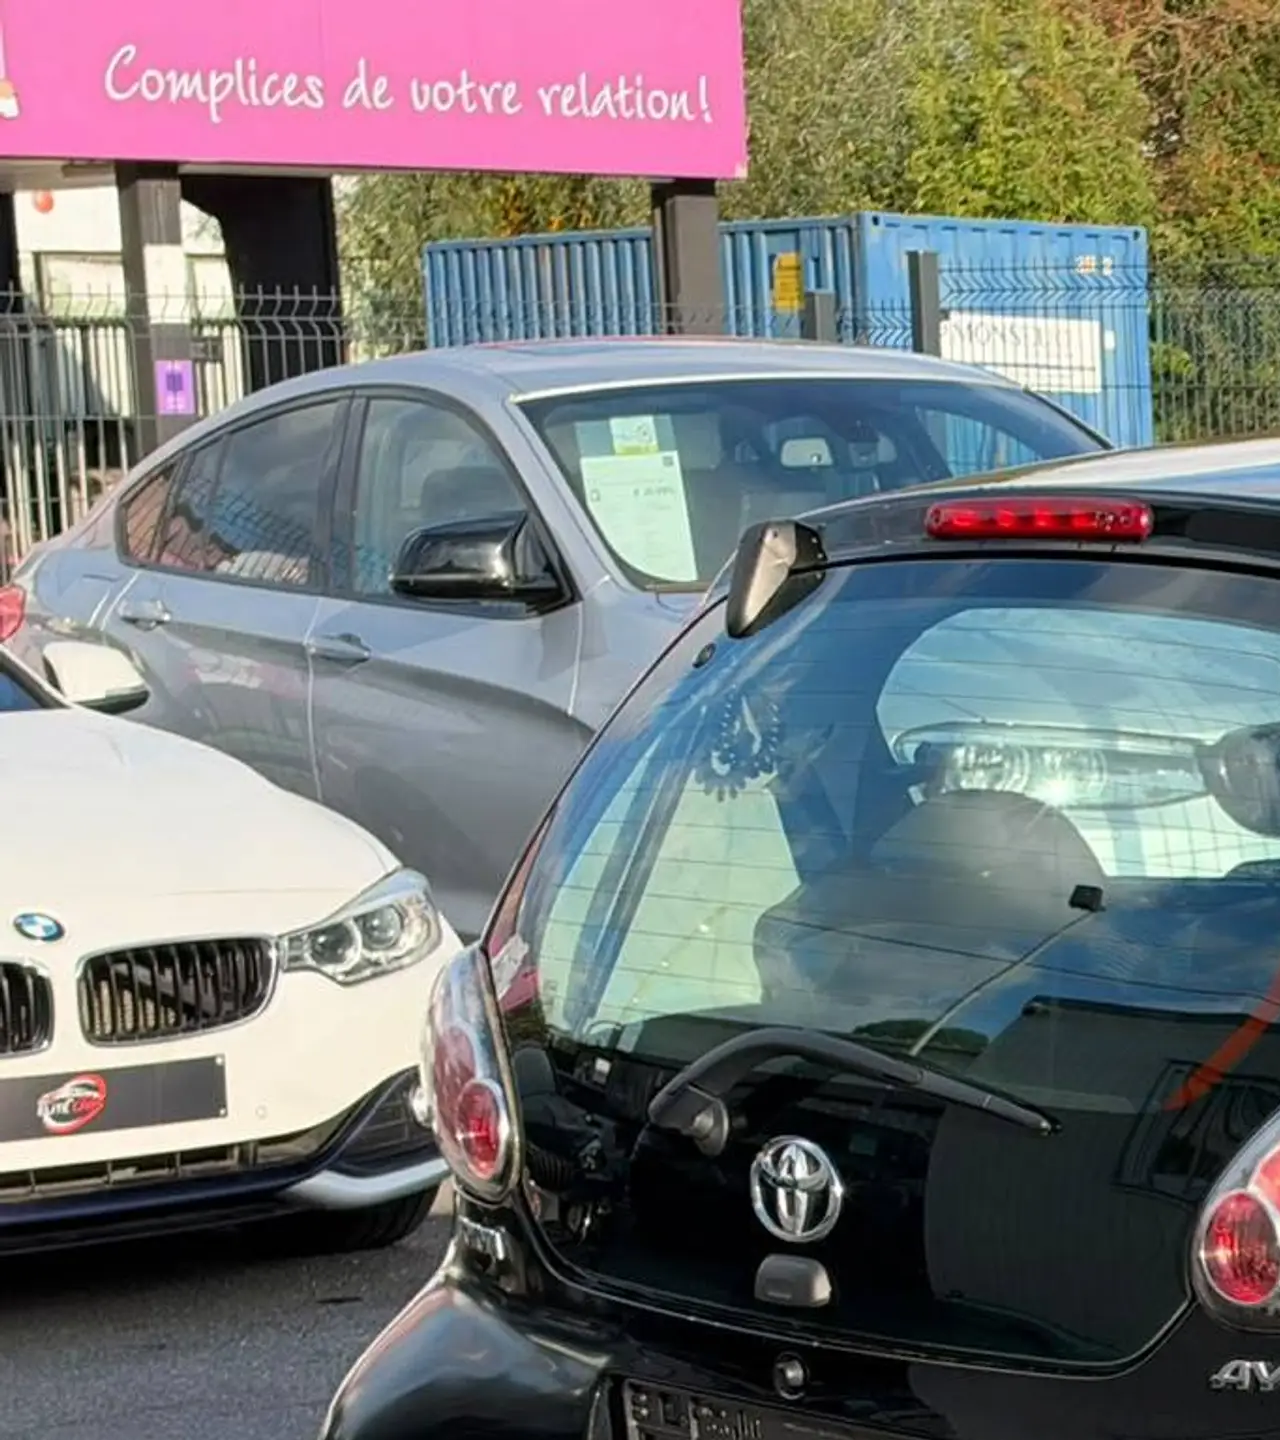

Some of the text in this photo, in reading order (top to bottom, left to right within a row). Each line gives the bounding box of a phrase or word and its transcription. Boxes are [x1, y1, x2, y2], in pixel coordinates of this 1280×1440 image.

[104, 44, 714, 124] Complices de votre relation!
